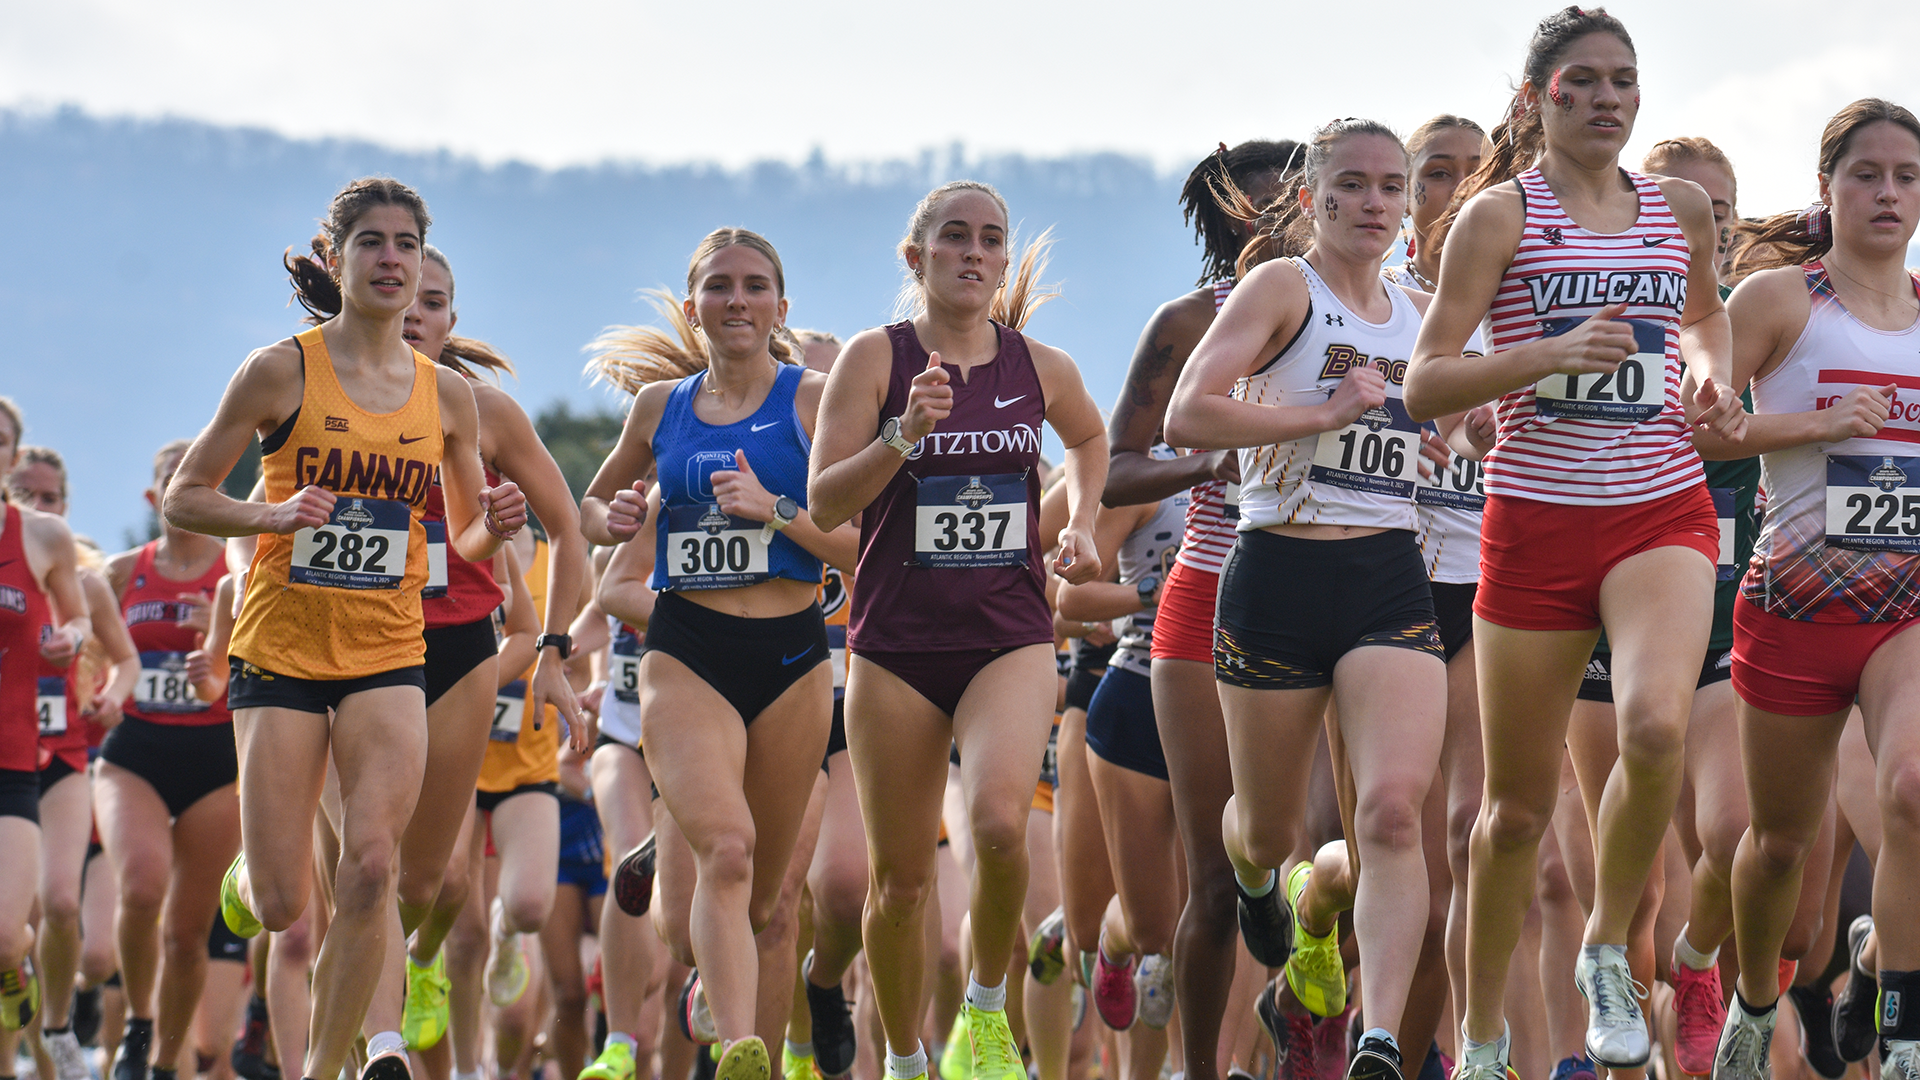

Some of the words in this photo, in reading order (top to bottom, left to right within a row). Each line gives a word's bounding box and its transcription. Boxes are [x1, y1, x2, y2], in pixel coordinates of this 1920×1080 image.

[1521, 271, 1687, 316] VULCANS
[1566, 360, 1644, 402] 120
[325, 420, 349, 429] PSAC
[1361, 413, 1391, 423] CHAMPIONSHIPS
[1551, 402, 1576, 410] ATLANTIC
[1629, 406, 1635, 414] 8,
[1635, 406, 1649, 414] 2025
[907, 423, 1041, 460] UTZTOWN
[1339, 430, 1405, 477] 106
[294, 446, 433, 509] GANNON
[1326, 470, 1348, 480] ATLANTIC
[1349, 475, 1366, 483] REGION
[1369, 478, 1391, 487] November
[1420, 489, 1441, 498] ATLANTIC
[1442, 492, 1460, 500] REGION
[337, 515, 373, 523] CHAMPIONSHIPS
[934, 511, 1011, 551] 337
[1845, 493, 1920, 535] 225
[309, 530, 389, 573] 282
[681, 536, 750, 574] 300
[305, 570, 328, 578] ATLANTIC
[328, 572, 347, 580] REGION
[1584, 671, 1611, 681] adidas
